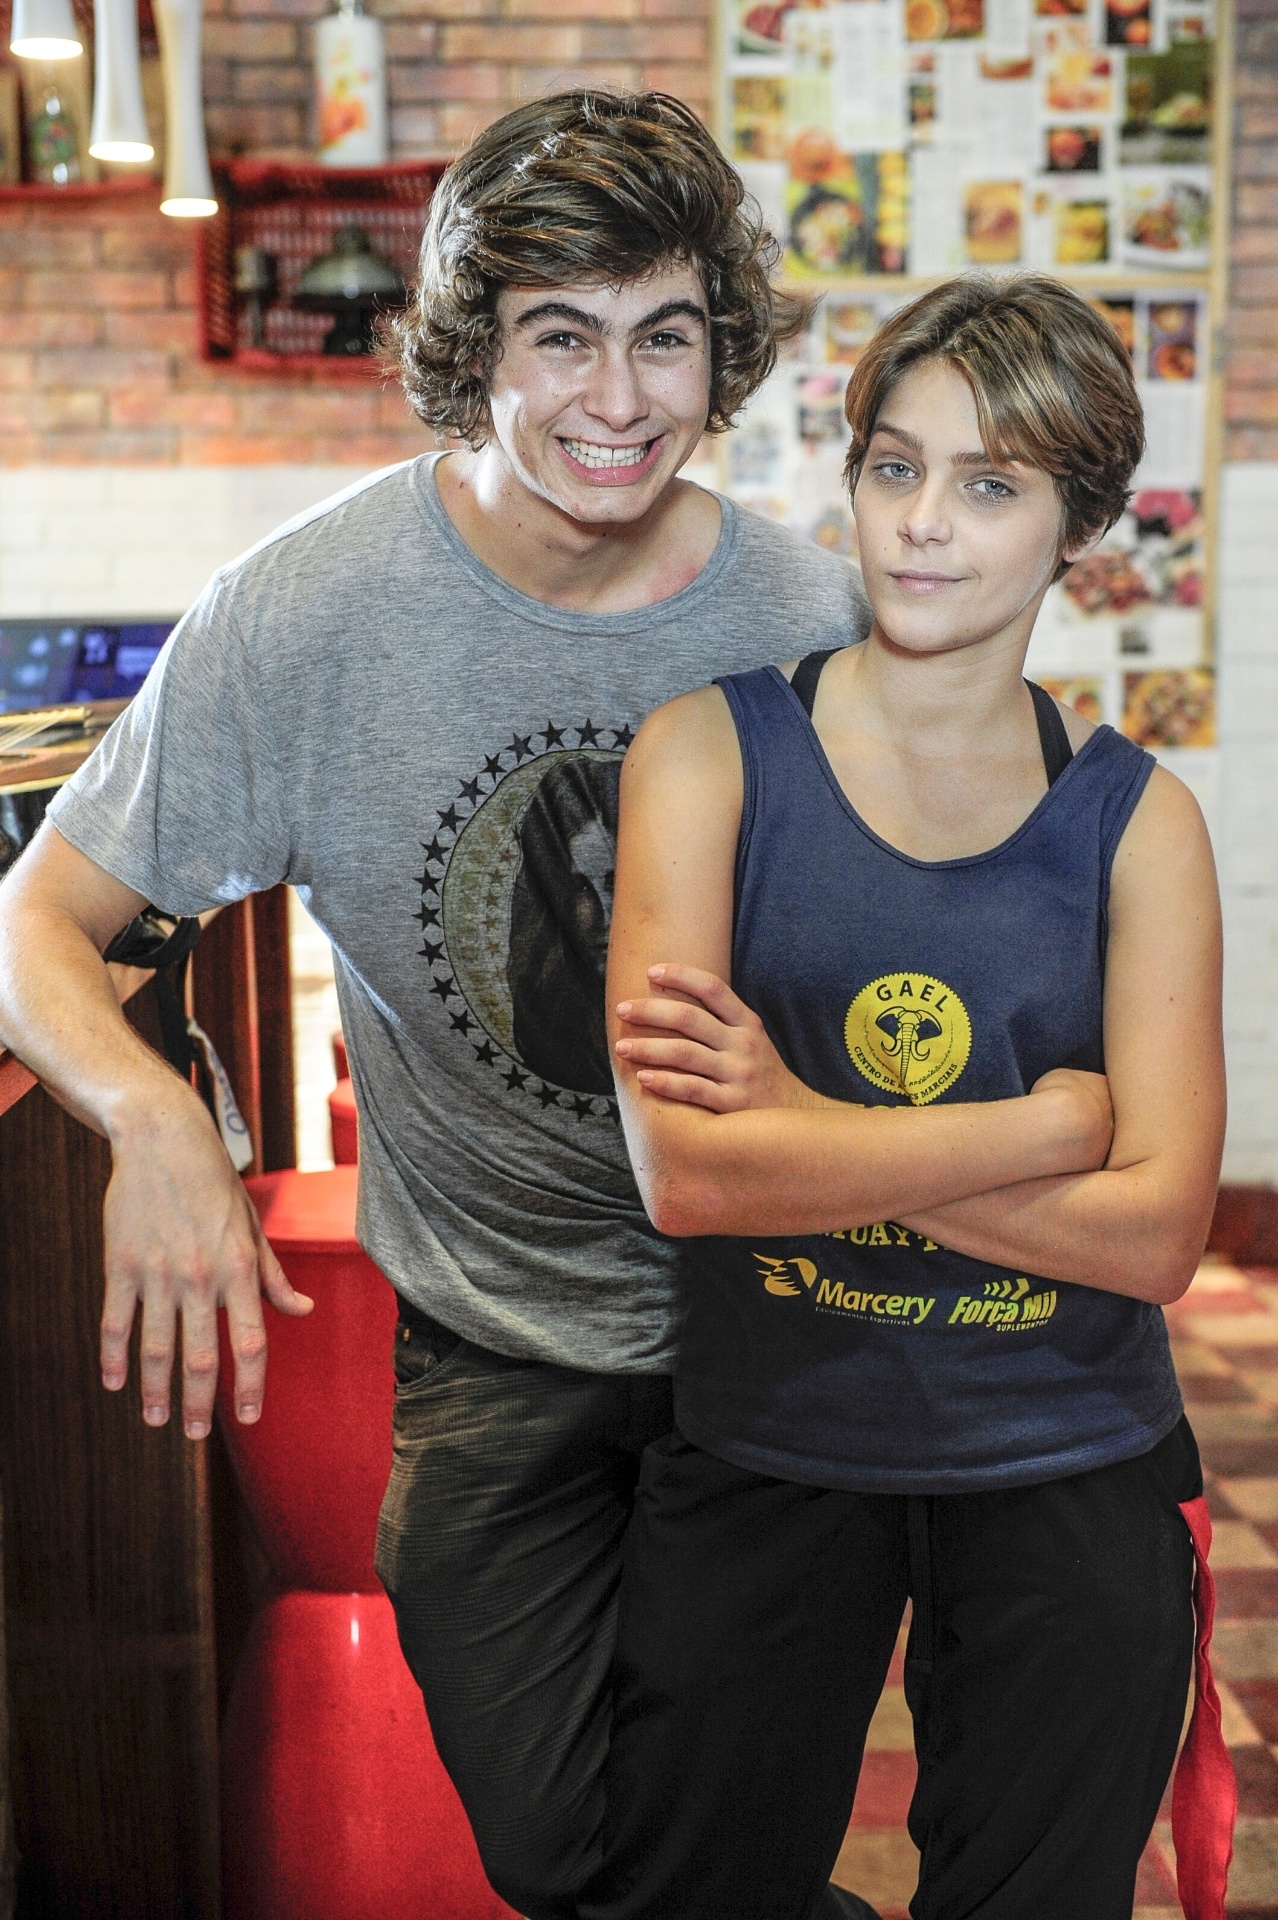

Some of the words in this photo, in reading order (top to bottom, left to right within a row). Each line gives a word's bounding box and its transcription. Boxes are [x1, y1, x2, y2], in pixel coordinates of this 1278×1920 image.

[876, 980, 949, 1013] GAEL
[854, 1046, 881, 1079] CENTRO
[883, 1075, 896, 1087] DE
[920, 1063, 958, 1098] MARCIAIS
[825, 1221, 910, 1247] UAY
[816, 1278, 936, 1325] Marcery
[948, 1296, 1019, 1328] Força
[1020, 1290, 1057, 1321] Mil
[869, 1315, 911, 1326] Esportivos
